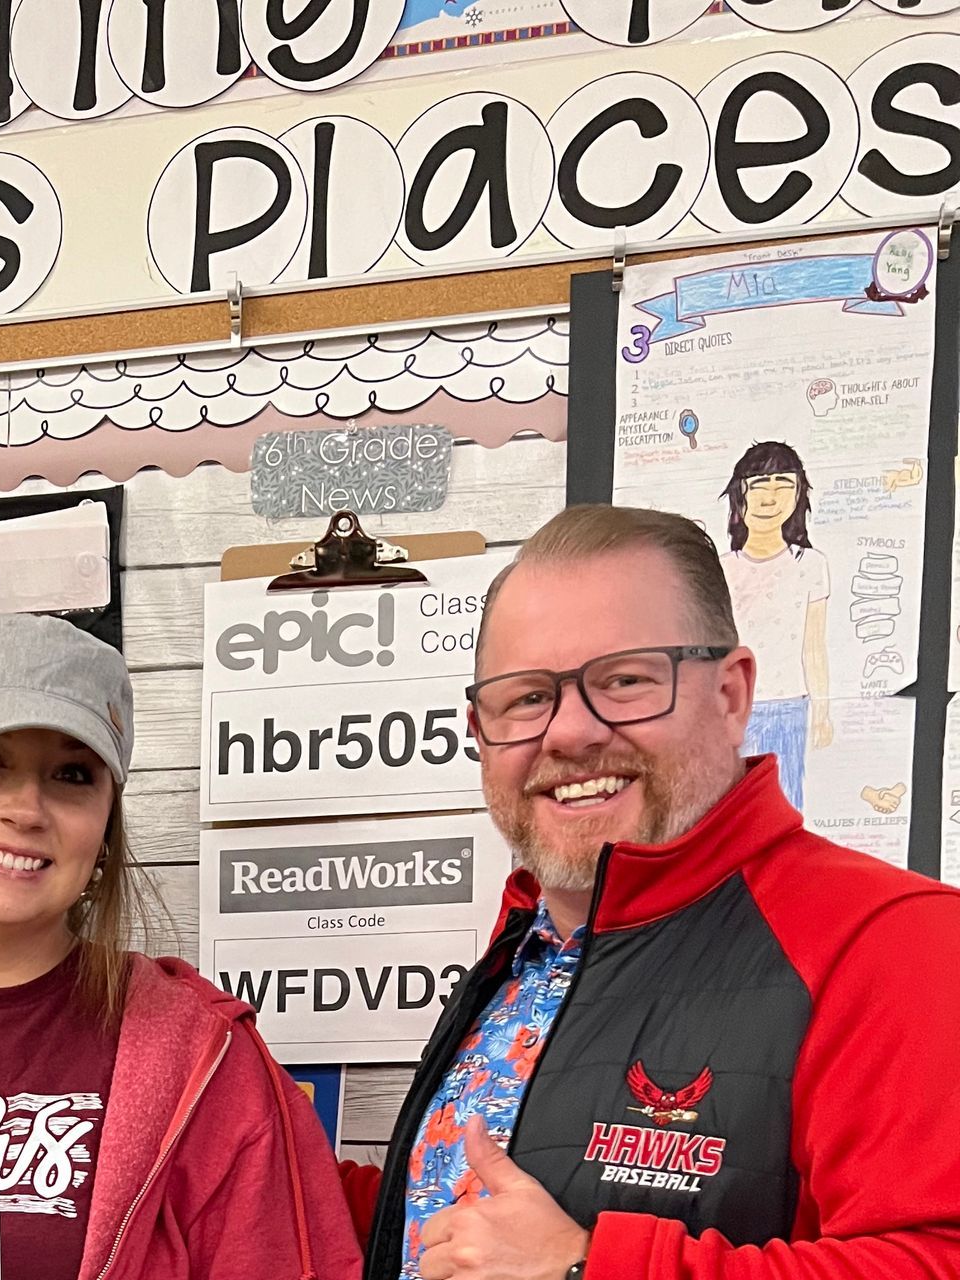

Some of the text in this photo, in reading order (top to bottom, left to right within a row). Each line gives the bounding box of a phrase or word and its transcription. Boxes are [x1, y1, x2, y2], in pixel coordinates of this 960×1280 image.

[189, 62, 960, 292] Places
[726, 271, 779, 301] Mia
[621, 324, 733, 364] 3 DIRECT QUOTES
[840, 381, 887, 395] THOUGHTS
[891, 376, 920, 390] ABOUT
[619, 409, 670, 425] APPEARANCE
[618, 423, 659, 436] PHYSICAL
[264, 427, 438, 467] 6th Grade
[833, 476, 888, 490] STRENGTHS
[301, 483, 397, 513] News
[856, 536, 906, 549] SYMBOLS
[215, 590, 395, 675] epic!
[860, 679, 889, 689] WANTS
[813, 818, 855, 828] VALUES
[863, 816, 908, 826] BELIEFS
[307, 914, 385, 930] Class Code
[583, 1122, 727, 1176] HAWKS
[600, 1165, 702, 1192] BASEBALL
